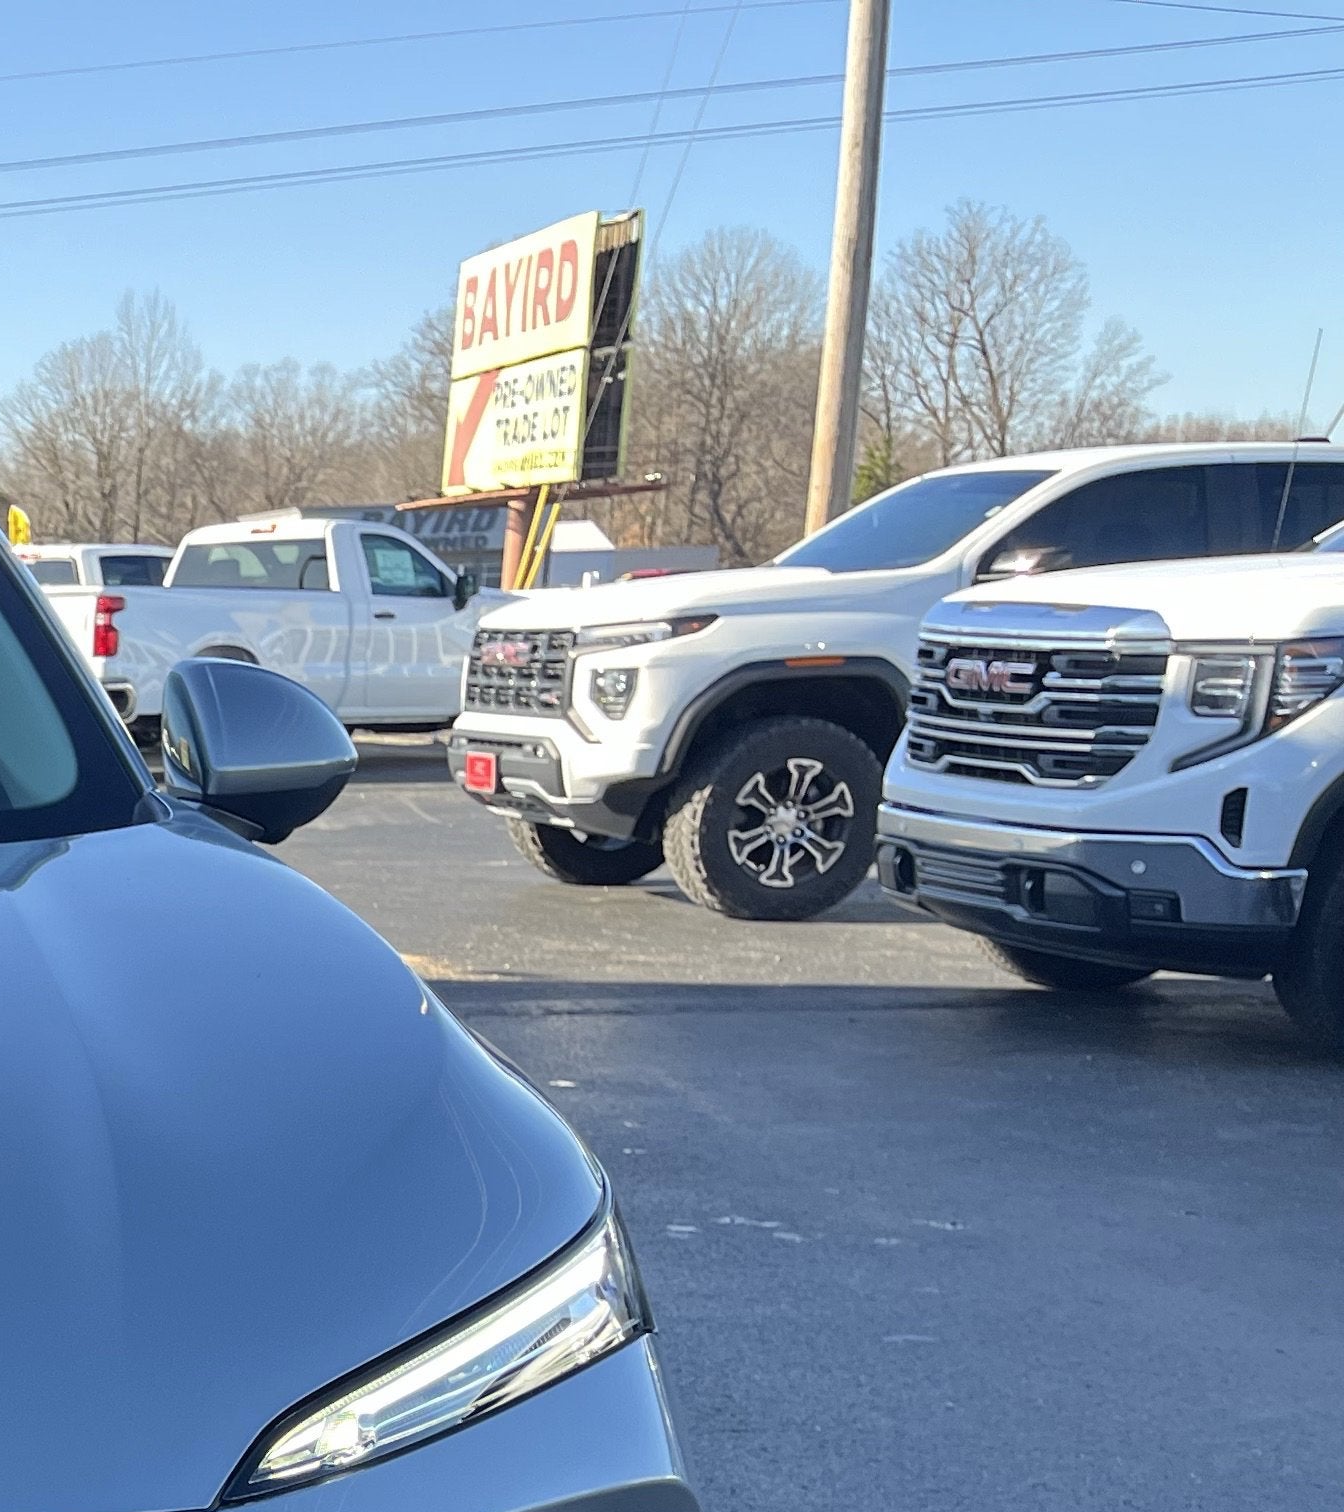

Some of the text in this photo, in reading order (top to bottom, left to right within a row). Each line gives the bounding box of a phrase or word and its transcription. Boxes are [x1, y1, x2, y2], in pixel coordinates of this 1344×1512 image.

[461, 239, 578, 350] BAYIRD
[494, 364, 577, 408] PRE-OWNED
[496, 405, 570, 446] TRADE LOT
[945, 658, 1037, 694] GMC
